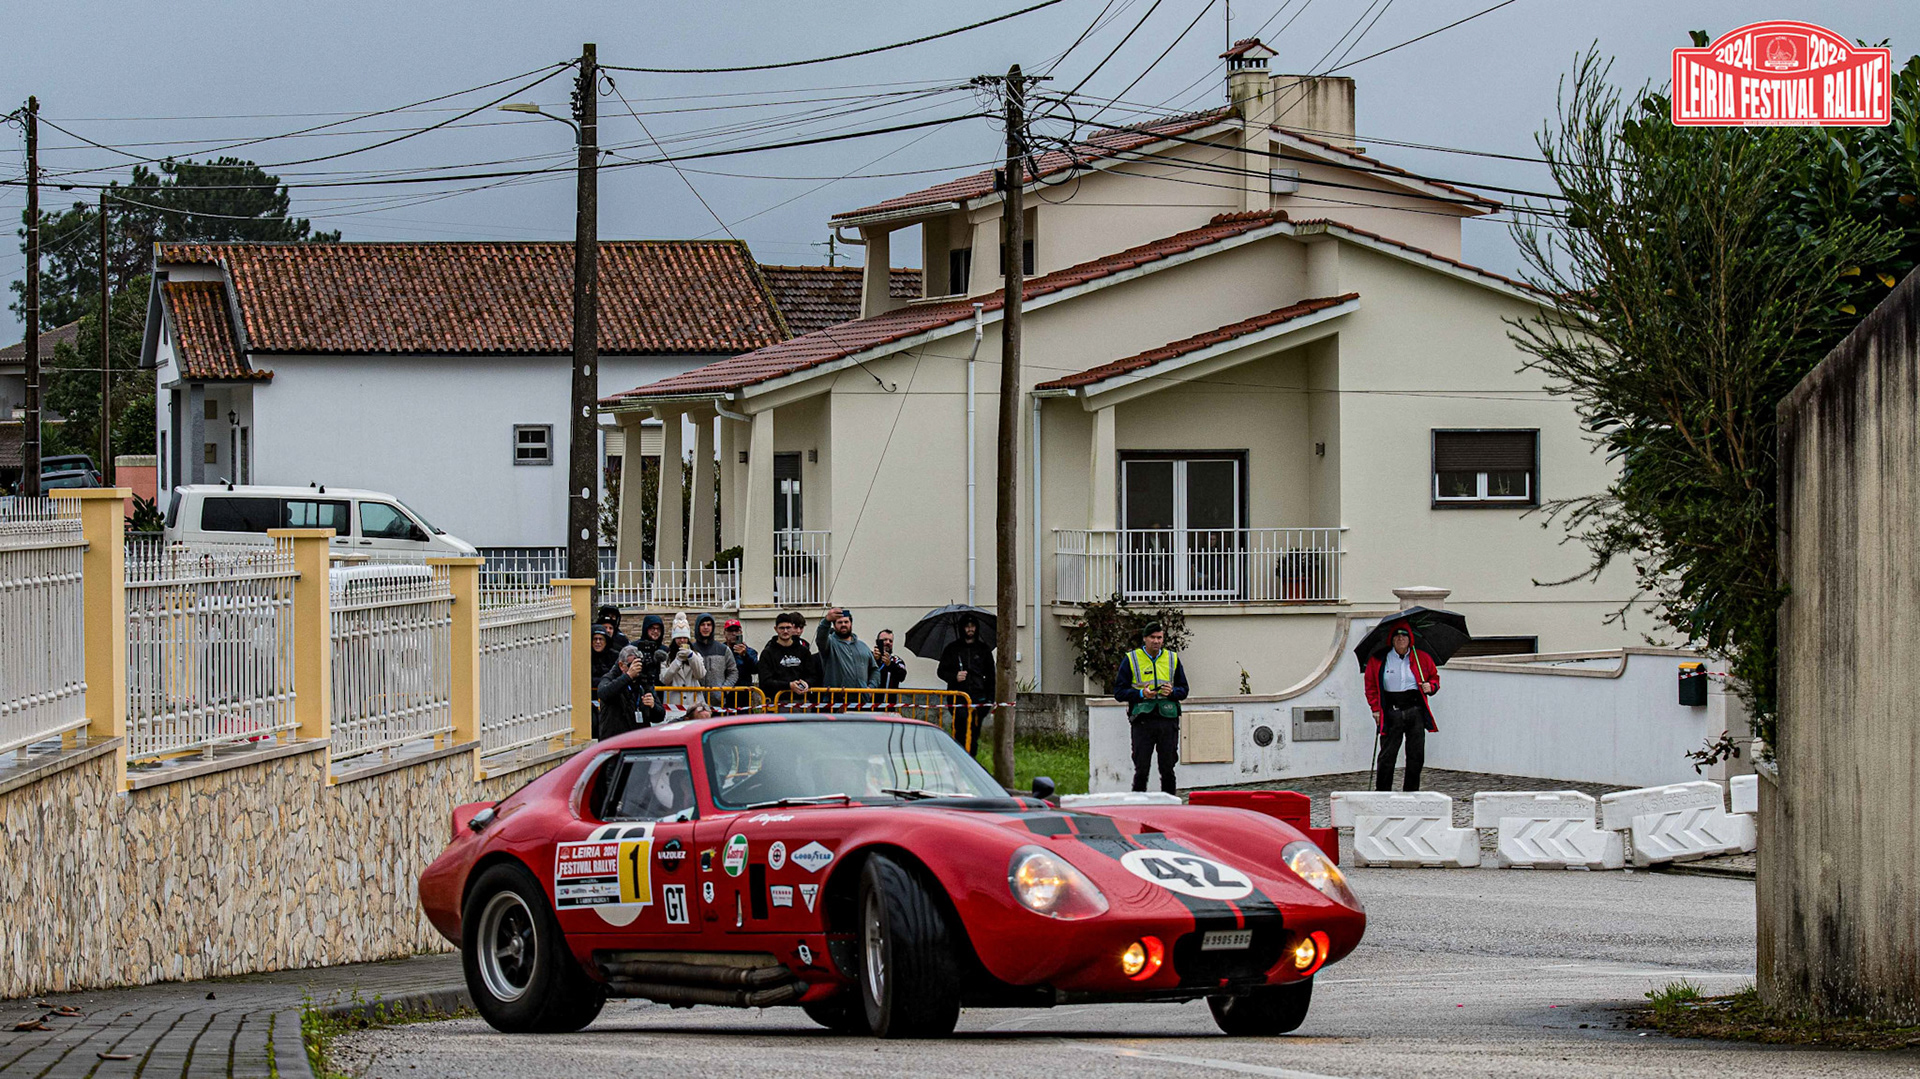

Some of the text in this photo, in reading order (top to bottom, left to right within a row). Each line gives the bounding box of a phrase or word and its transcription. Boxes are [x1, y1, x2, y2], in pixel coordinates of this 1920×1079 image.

[571, 845, 617, 859] LEIRIA 2024
[657, 850, 687, 860] VAZQUEZ
[727, 845, 747, 859] Castrol
[559, 859, 616, 875] FESTIVAL RALLYE
[629, 844, 640, 899] 1
[1140, 858, 1248, 888] 42
[665, 887, 685, 922] GT
